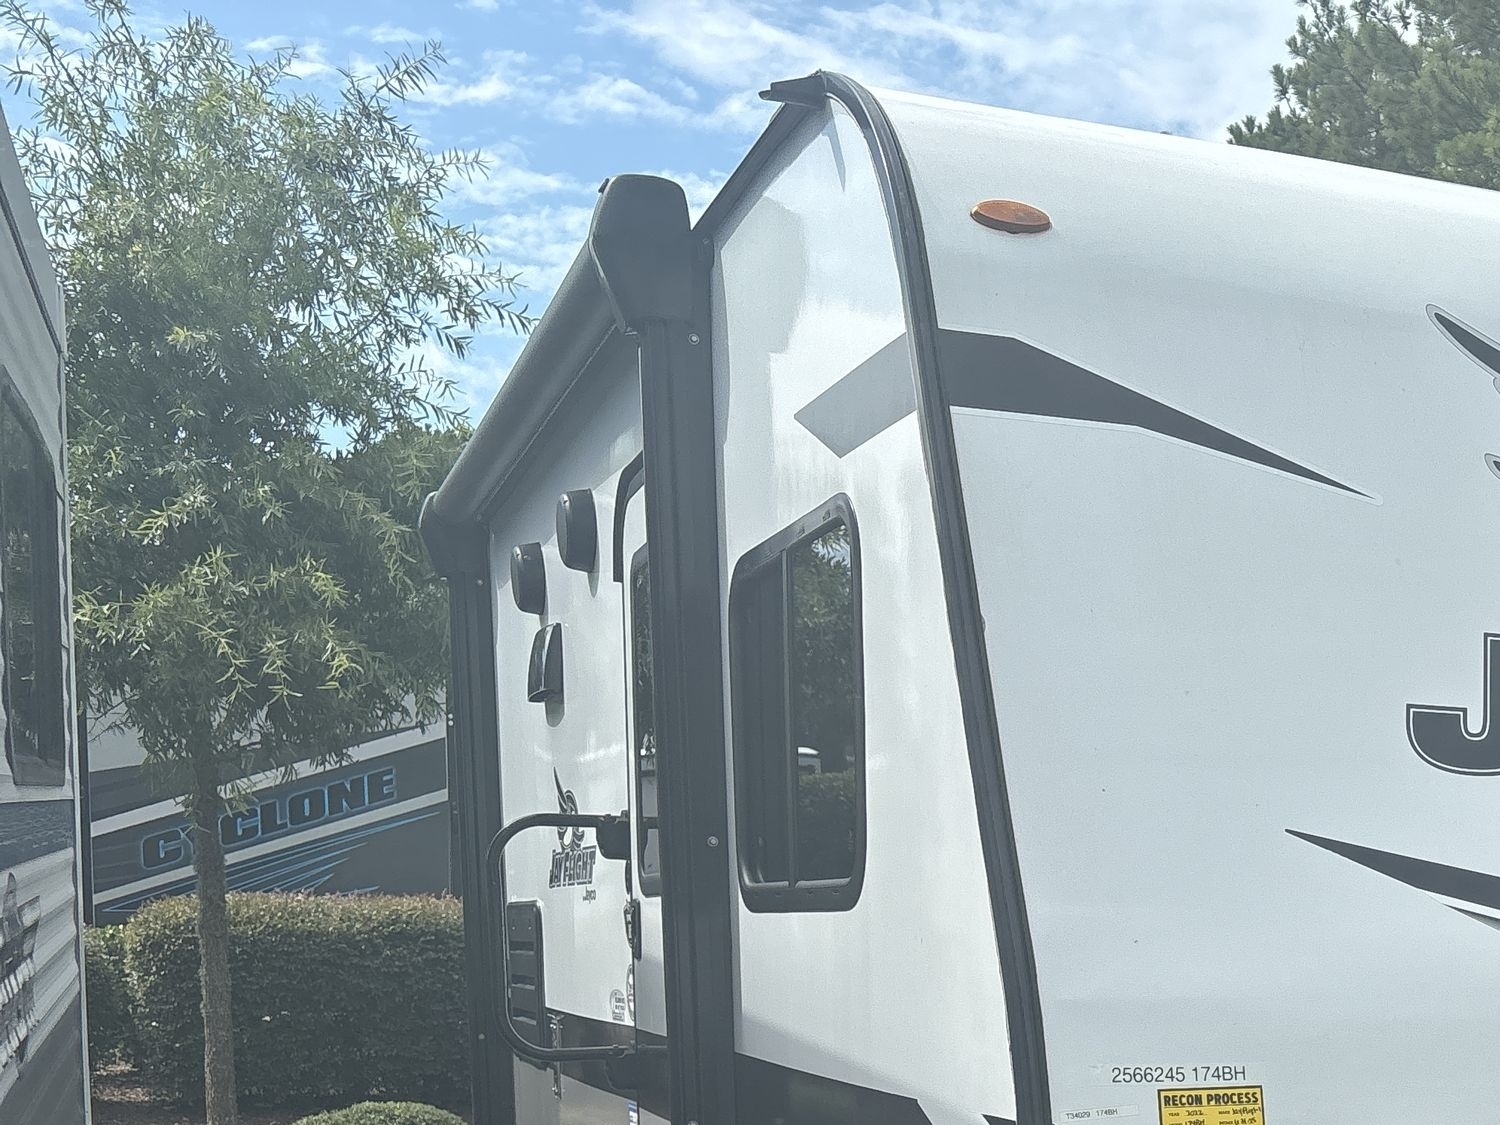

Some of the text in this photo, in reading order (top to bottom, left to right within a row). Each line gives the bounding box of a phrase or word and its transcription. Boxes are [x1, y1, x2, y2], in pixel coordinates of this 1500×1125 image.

[141, 766, 398, 870] CCLONE
[1111, 1065, 1246, 1083] 2566245 174BH
[1163, 1092, 1259, 1106] RECON PROCESS
[1096, 1108, 1118, 1116] 174BH
